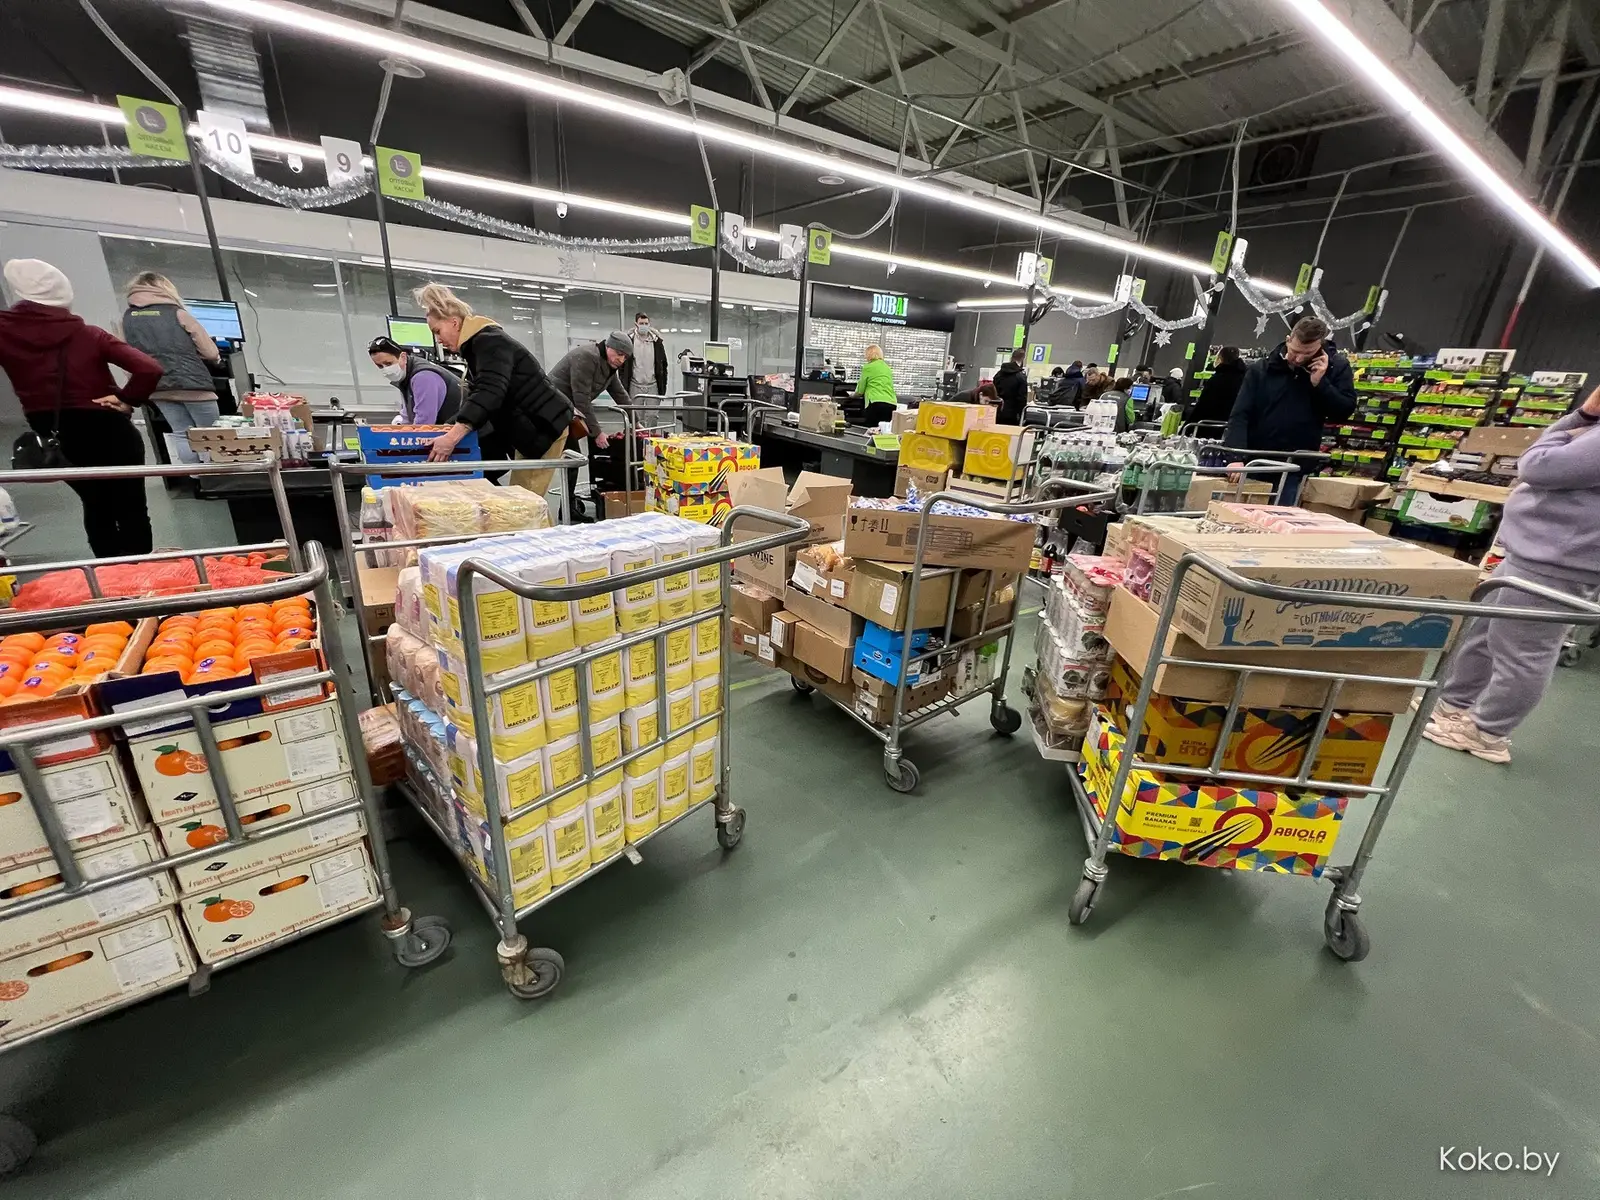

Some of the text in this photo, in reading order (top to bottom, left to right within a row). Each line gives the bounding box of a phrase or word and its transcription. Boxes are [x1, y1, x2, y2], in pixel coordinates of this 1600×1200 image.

[209, 129, 242, 154] 10
[336, 152, 351, 173] 9
[732, 224, 739, 238] 8
[790, 234, 798, 250] 7
[1028, 263, 1033, 274] 6
[872, 293, 909, 317] DUBAI
[1034, 346, 1044, 360] P
[1300, 610, 1365, 626] СЫТНЫЙ ОБЕД
[508, 718, 526, 727] МАССА
[1144, 817, 1177, 825] BANANAS
[1274, 827, 1327, 839] ABIOLA
